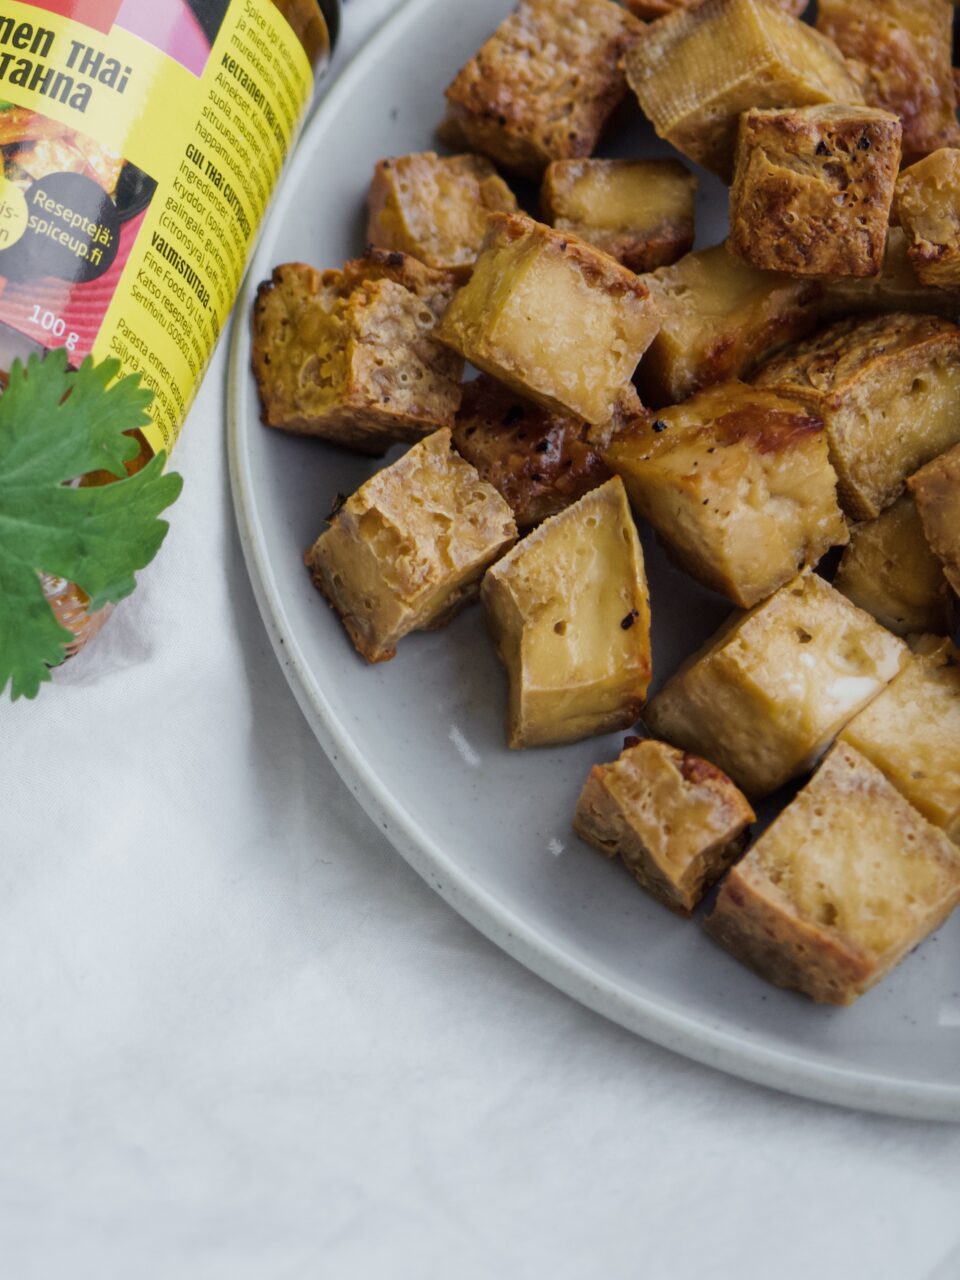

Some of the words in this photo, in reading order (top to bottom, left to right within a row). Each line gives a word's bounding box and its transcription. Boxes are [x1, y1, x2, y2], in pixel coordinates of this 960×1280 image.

[236, 15, 247, 31] ja
[247, 26, 272, 62] mietoa
[209, 89, 233, 120] suola,
[172, 177, 206, 215] kryddor
[179, 159, 229, 221] Ingredienser:
[27, 215, 104, 266] spiceup.fi
[32, 189, 114, 248] Reseptejä:
[159, 210, 206, 267] (citronsyra),
[166, 194, 207, 242] galingale,
[136, 268, 163, 299] Katso
[143, 251, 164, 276] Fine
[163, 270, 187, 302] Foods
[185, 295, 196, 315] Oy
[27, 304, 66, 338] 100
[65, 332, 80, 351] g
[130, 284, 168, 327] Sertifioitu
[167, 320, 190, 359] ISO9001
[109, 335, 140, 371] Säilytä
[116, 317, 149, 356] Parasta
[148, 351, 171, 383] ennen:
